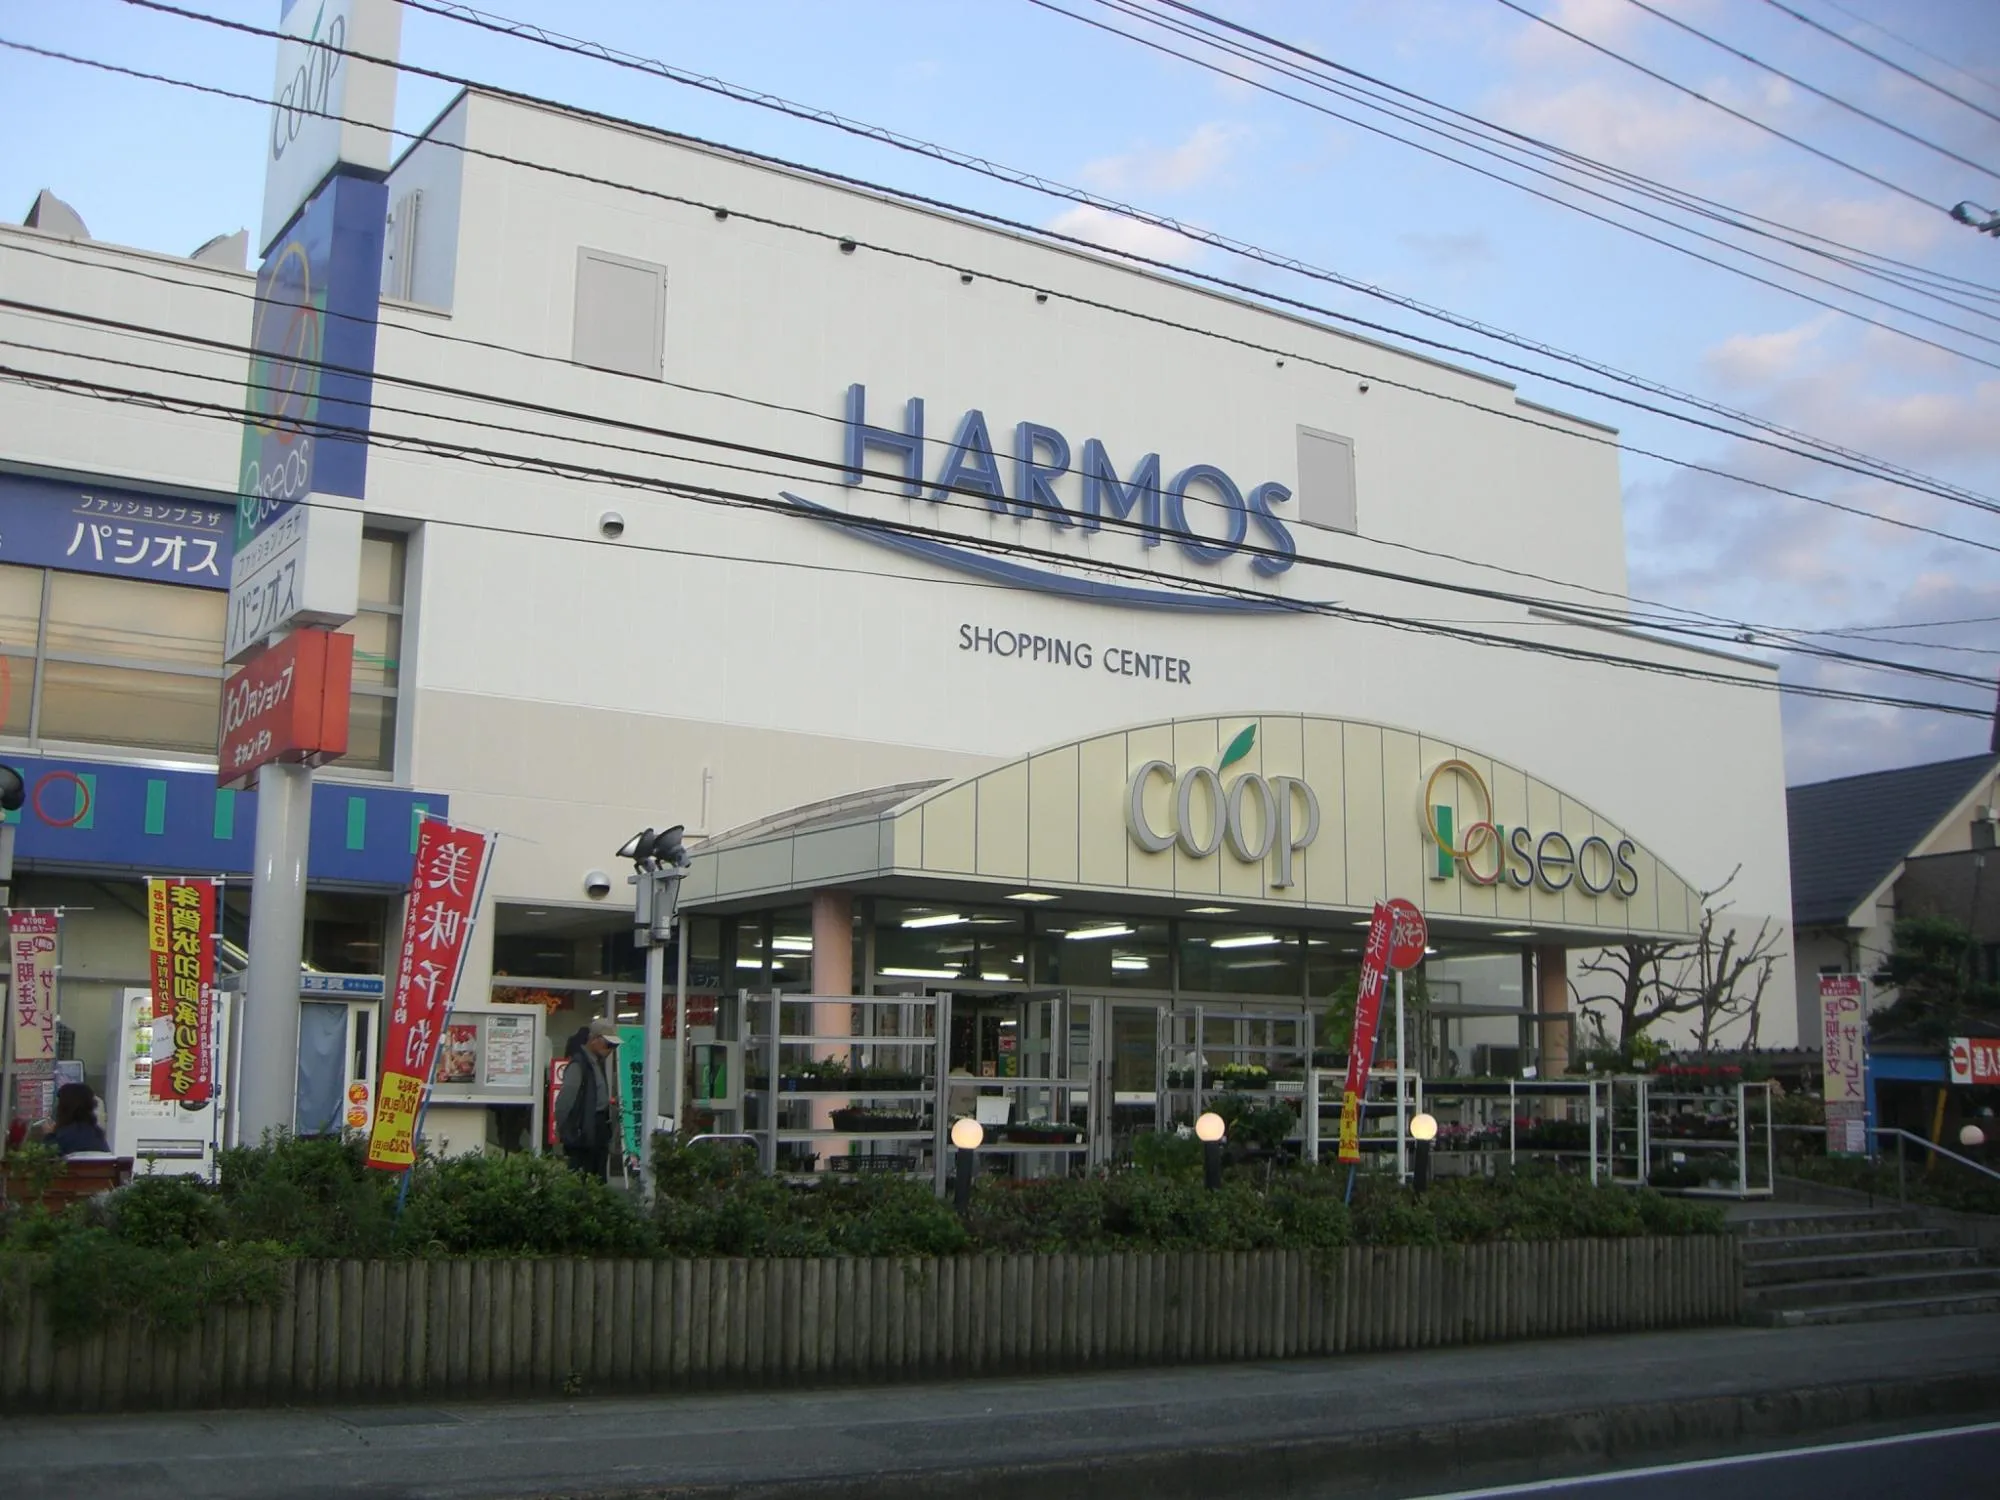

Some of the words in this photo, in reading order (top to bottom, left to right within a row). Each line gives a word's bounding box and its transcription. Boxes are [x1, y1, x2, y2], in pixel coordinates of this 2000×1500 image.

[80, 494, 222, 527] ファッションプラザ
[842, 383, 1297, 578] HARMOS
[66, 522, 220, 576] パシオス
[232, 558, 296, 651] パシオス
[959, 623, 1093, 670] SHOPPING
[1103, 648, 1192, 685] CENTER
[1418, 759, 1639, 899] Paseos
[1972, 1046, 2000, 1077] 進入
